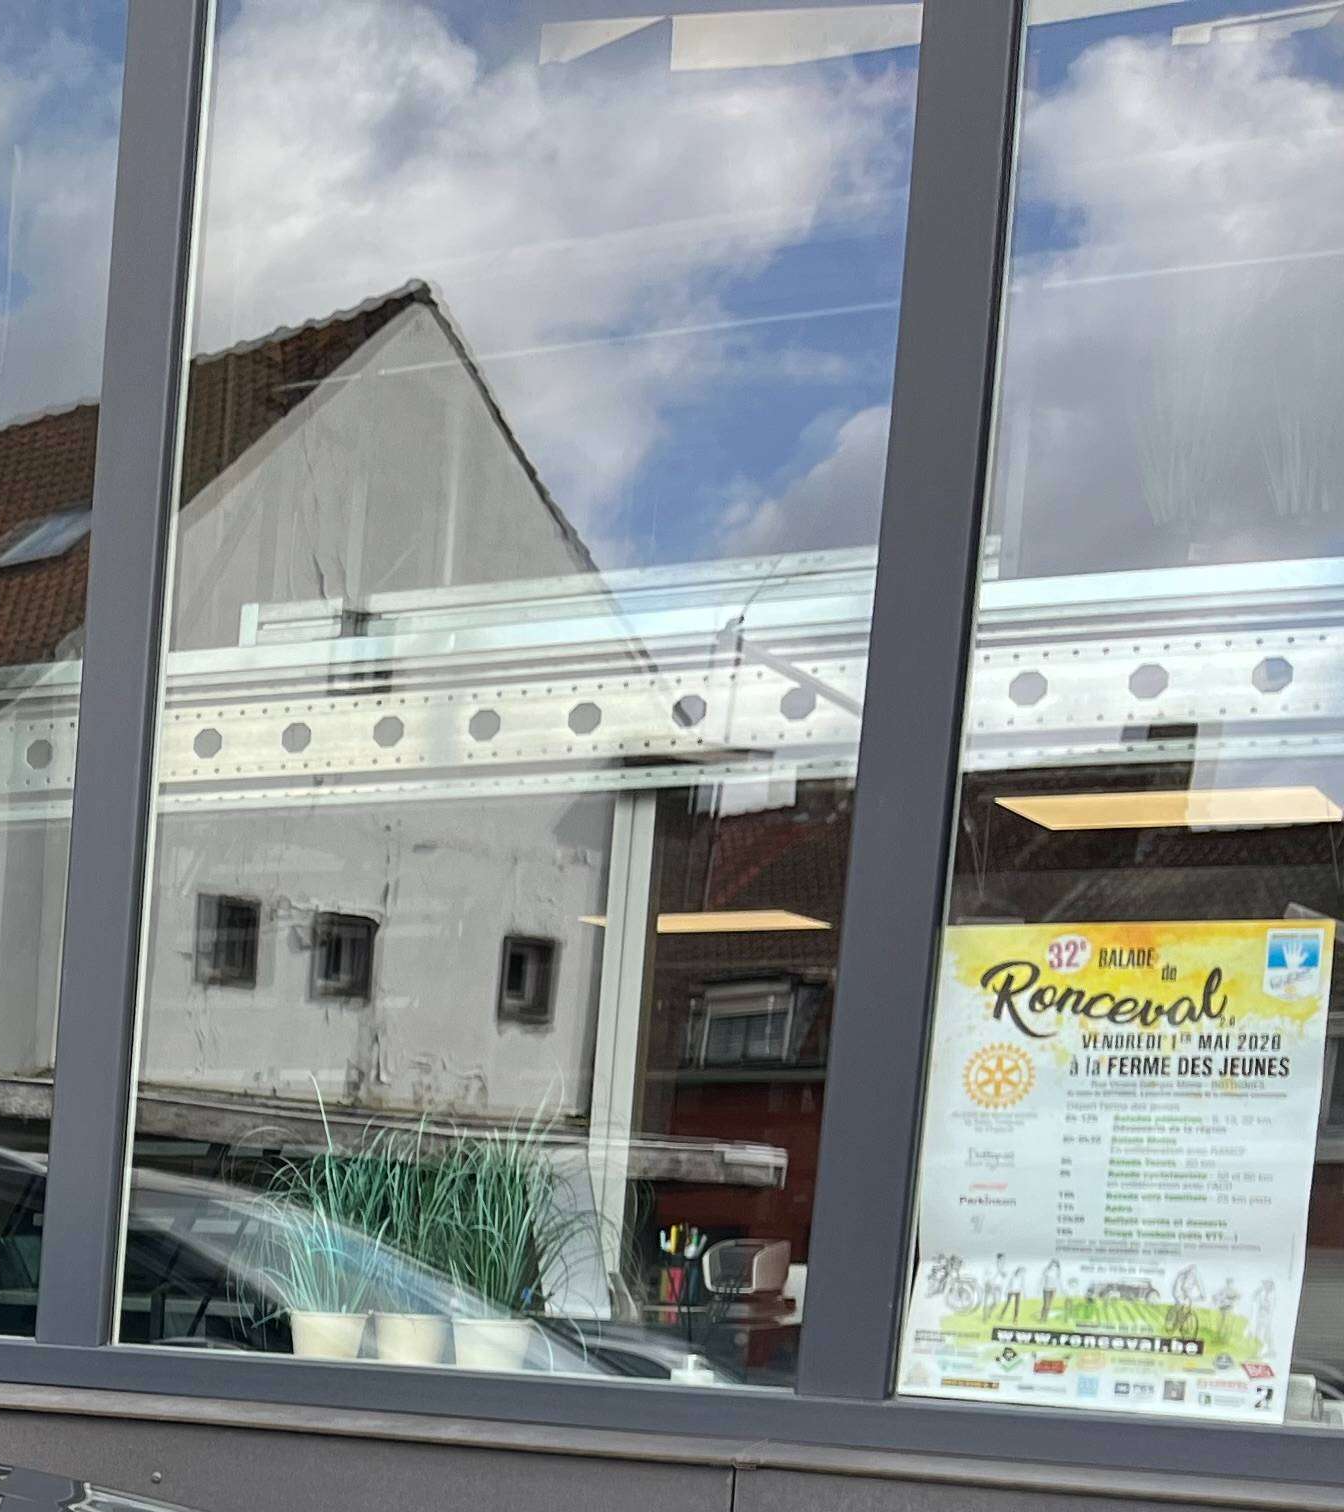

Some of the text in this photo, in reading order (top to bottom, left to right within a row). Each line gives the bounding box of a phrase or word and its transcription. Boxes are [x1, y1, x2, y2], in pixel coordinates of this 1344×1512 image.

[1098, 947, 1155, 968] BALADE
[1161, 963, 1177, 982] de
[980, 961, 1228, 1038] Ronceval
[1082, 1032, 1163, 1051] VENDREDI
[1198, 1033, 1230, 1051] MAI
[1069, 1055, 1290, 1078] à la FERME DES JEUNES
[997, 1329, 1199, 1355] www.ronceval.be
